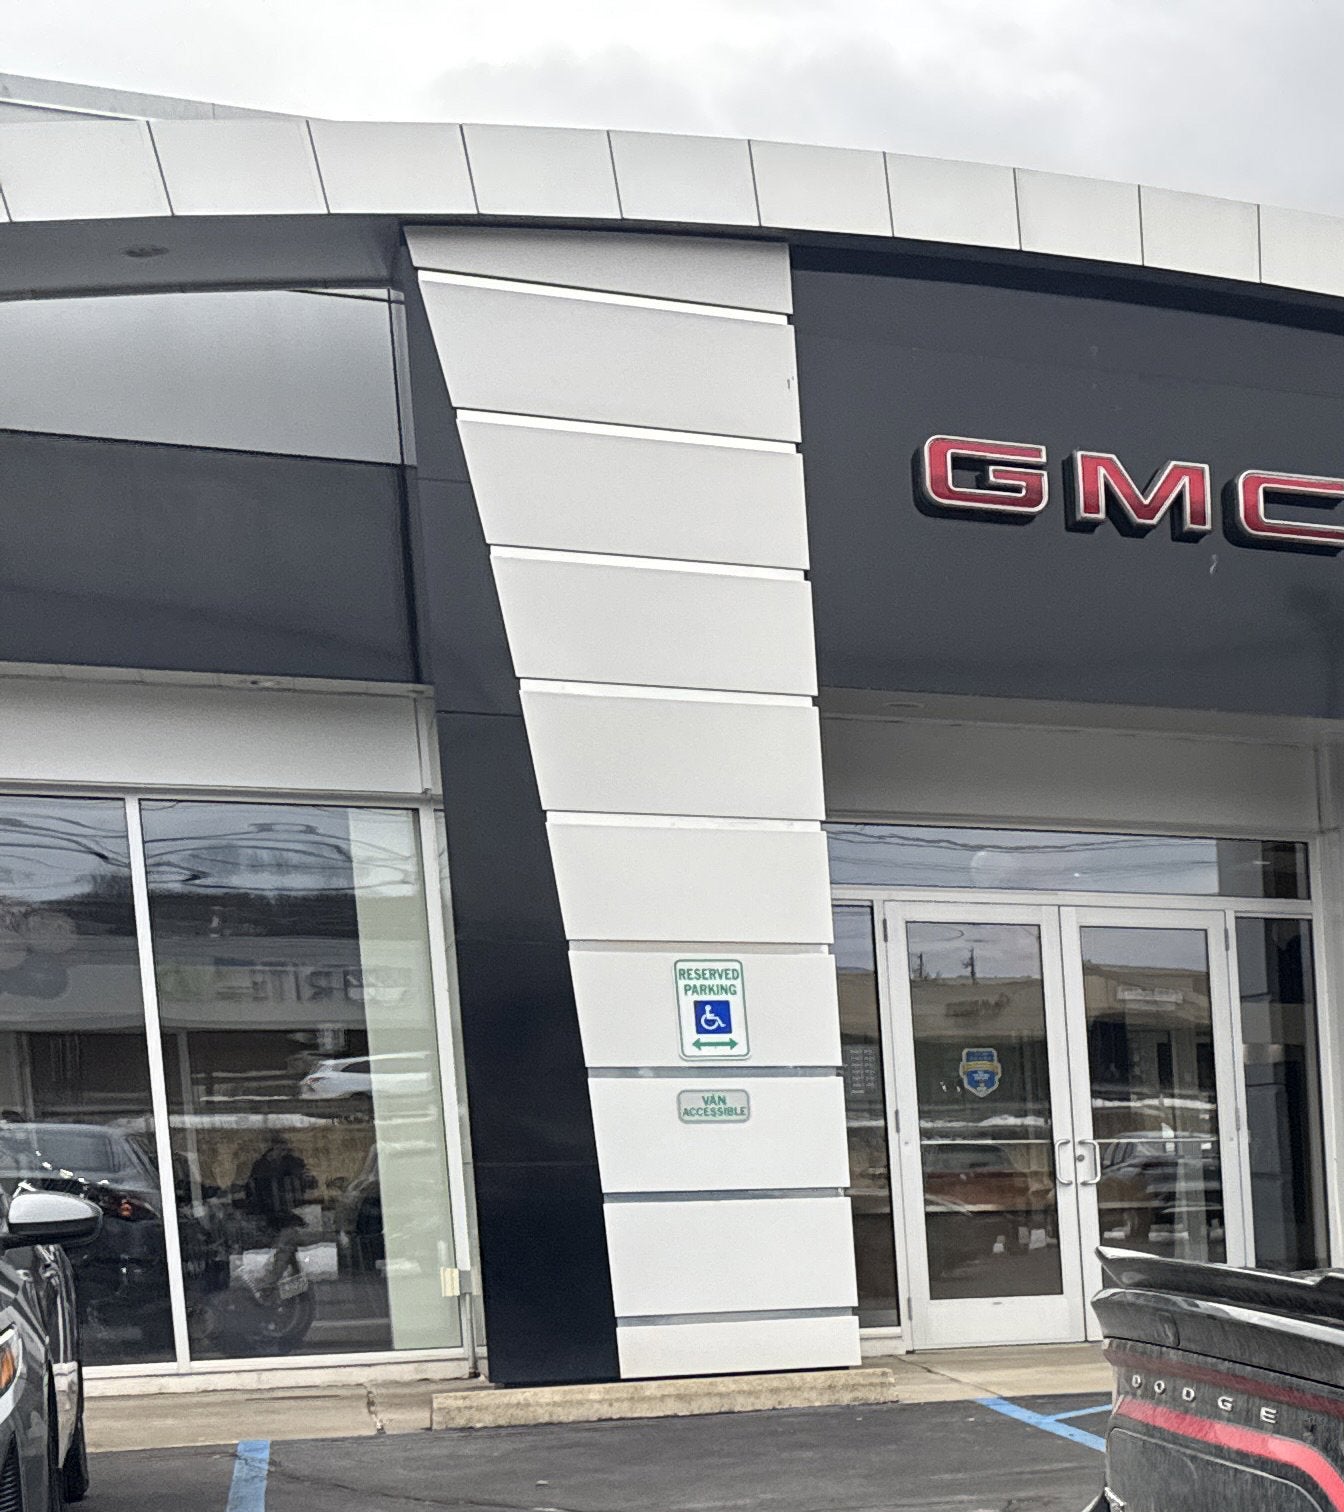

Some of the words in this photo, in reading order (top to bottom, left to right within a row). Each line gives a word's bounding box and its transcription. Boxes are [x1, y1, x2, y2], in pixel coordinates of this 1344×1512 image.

[678, 968, 740, 981] RESERVED
[684, 983, 737, 996] PARKING
[702, 1095, 727, 1106] VAN
[683, 1107, 747, 1118] ACCESSIBLE
[1131, 1374, 1278, 1424] DODGE
